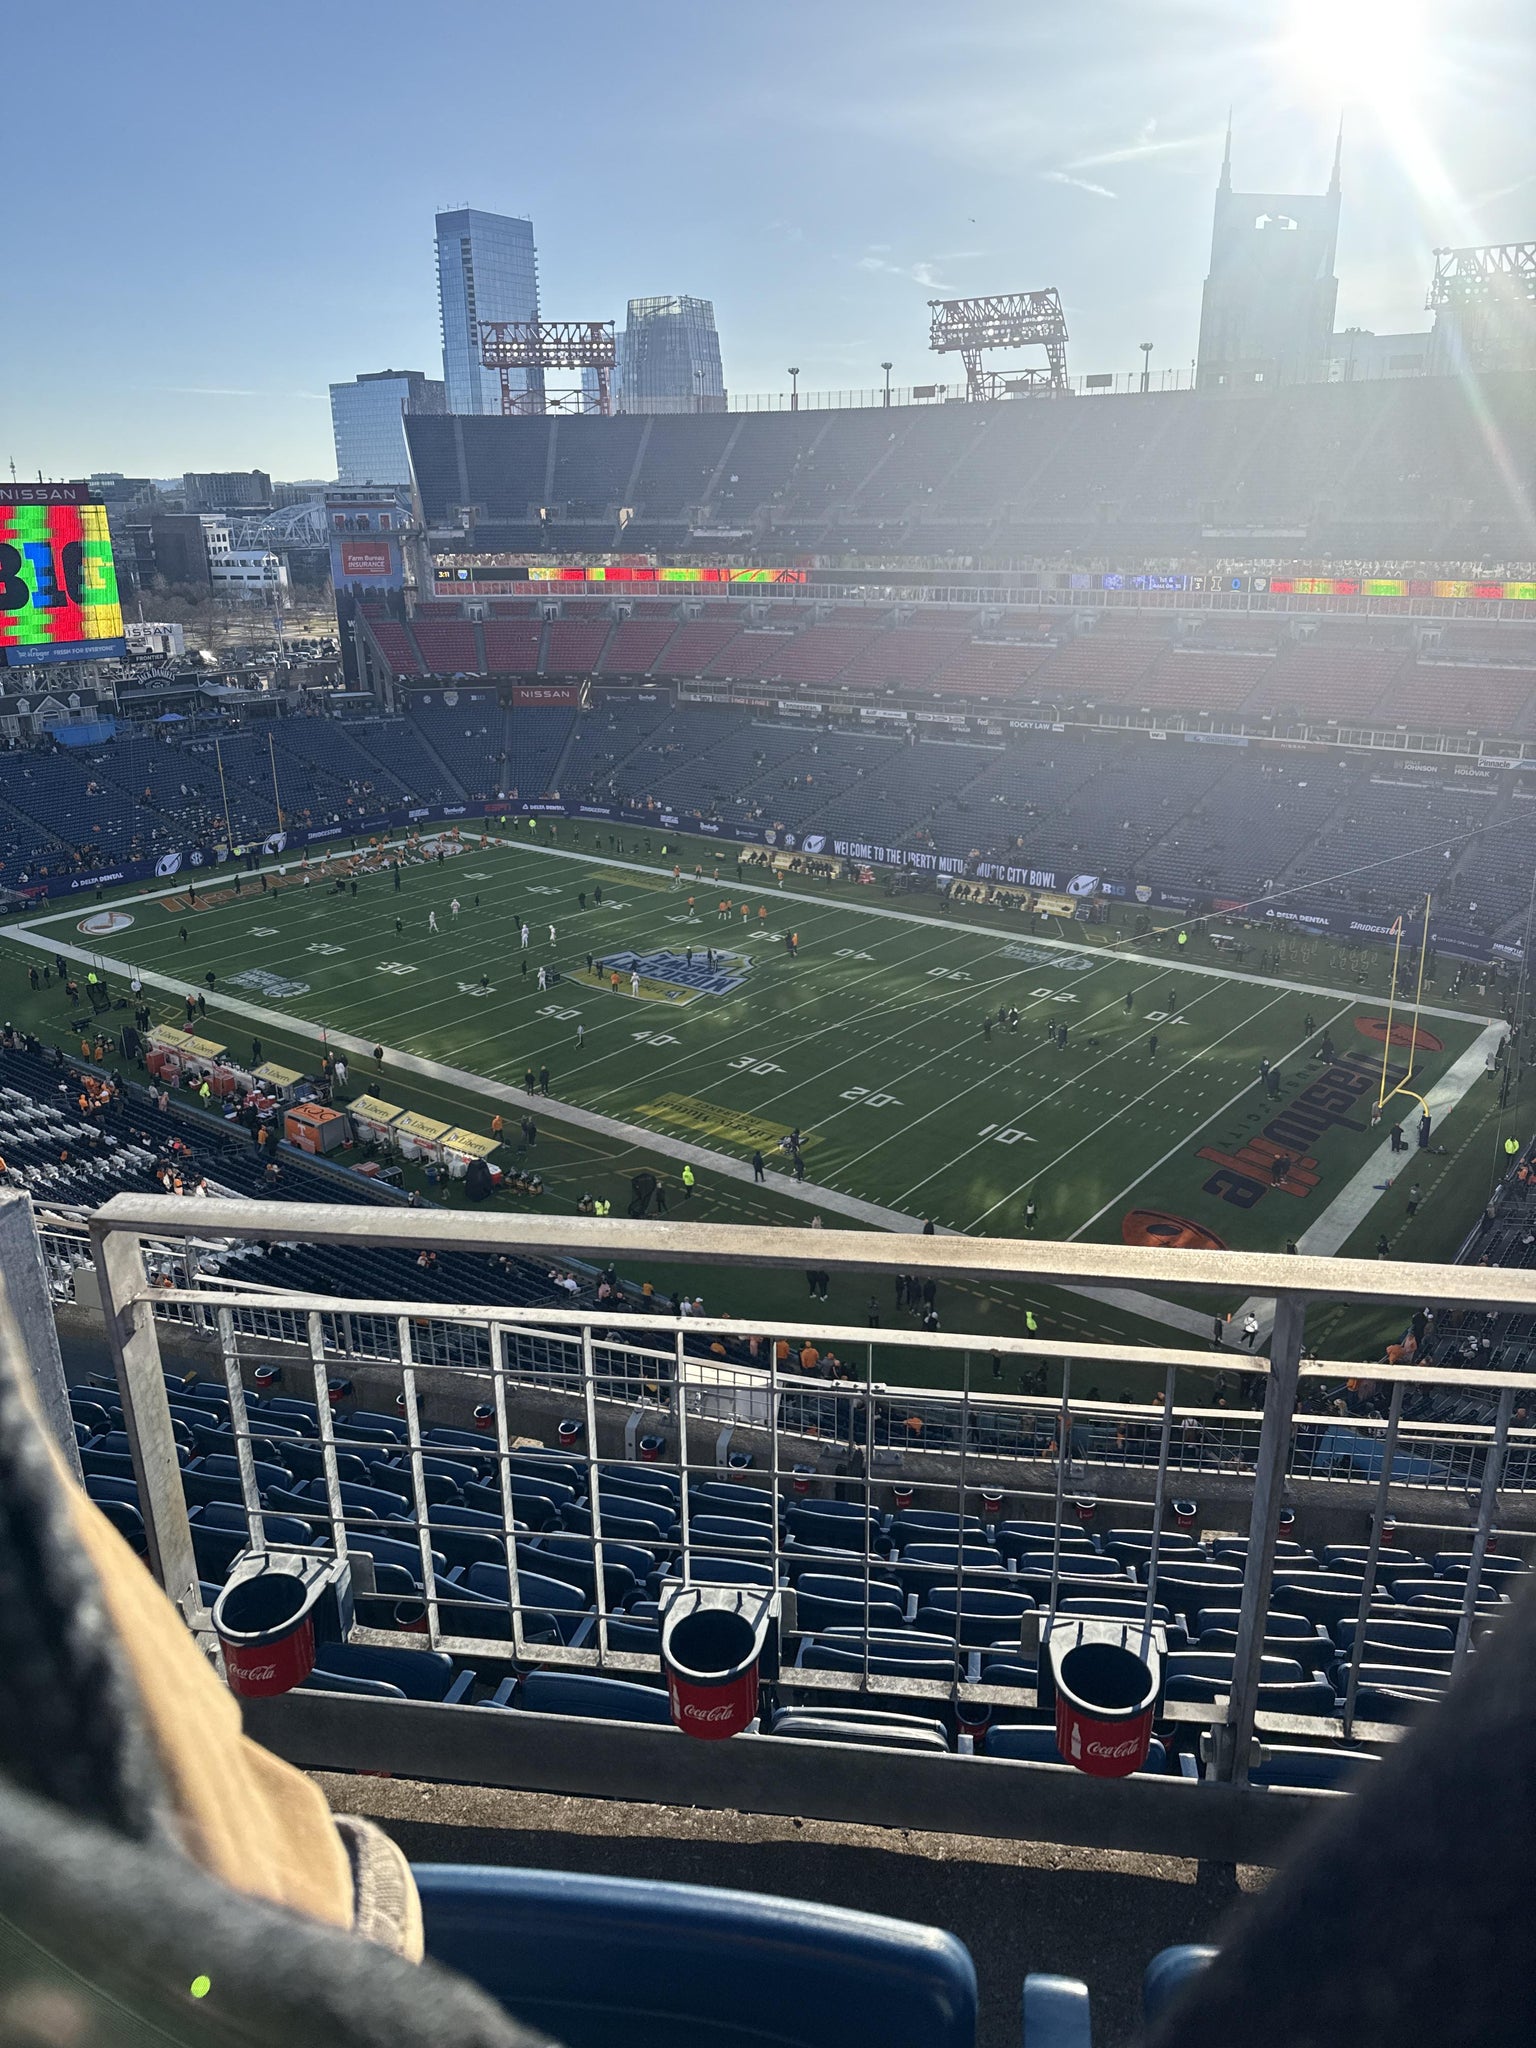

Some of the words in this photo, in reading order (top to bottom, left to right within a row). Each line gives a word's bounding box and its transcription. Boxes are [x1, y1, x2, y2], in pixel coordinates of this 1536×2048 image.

[0, 489, 77, 500] NISSAN
[127, 627, 173, 637] ISSAN
[136, 654, 164, 662] FRONTIER
[520, 690, 571, 699] NISSAN
[1009, 720, 1033, 728] ROCKY
[1035, 722, 1050, 730] LAW
[1404, 764, 1438, 773] JOHNSON
[1479, 758, 1511, 769] Pinnacle
[1454, 769, 1490, 778] HOLOVAK
[834, 840, 872, 859] WELCOME
[873, 845, 884, 861] TO
[885, 847, 901, 864] THE
[939, 856, 971, 876] MUTU
[1007, 866, 1029, 884] CITY
[1030, 870, 1057, 889] BOWL
[80, 877, 99, 886] DELTA
[99, 872, 124, 882] DENTAL
[1276, 911, 1298, 921] DELTA
[1299, 914, 1330, 925] DENTAL
[1349, 921, 1407, 937] BRIDGESTONE
[305, 942, 347, 955] 20
[375, 961, 419, 975] 30
[535, 1004, 583, 1020] 50
[630, 1030, 673, 1047] 40
[728, 1055, 775, 1076] 30
[268, 1069, 290, 1083] Liberty
[840, 1086, 894, 1108] 20
[363, 1102, 390, 1119] Liberty
[652, 1100, 714, 1122] Mutual
[691, 1101, 762, 1124] INSURANCE
[411, 1120, 437, 1135] Liberty
[976, 1123, 1027, 1145] 10
[458, 1136, 487, 1152] Liberty
[229, 1663, 276, 1681] Coca-Cola
[684, 1703, 736, 1722] Coca-Cola
[1087, 1736, 1140, 1758] Coca-Cola
